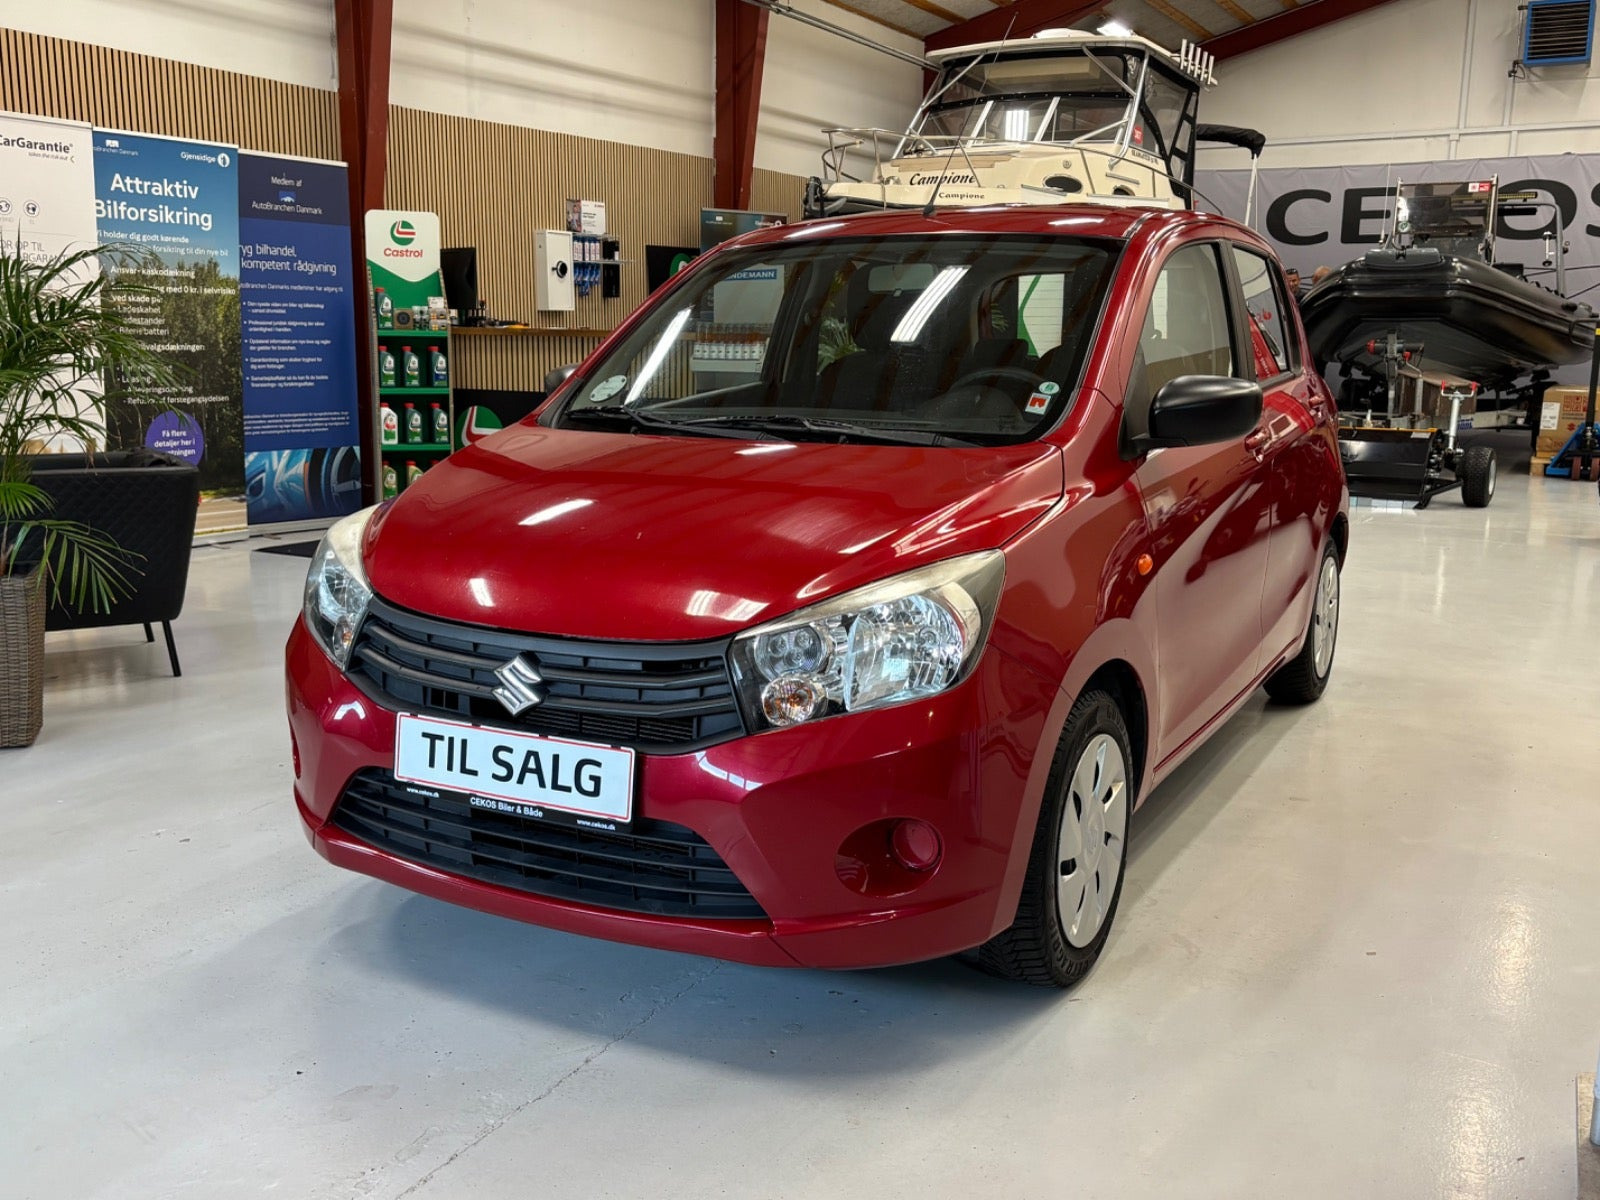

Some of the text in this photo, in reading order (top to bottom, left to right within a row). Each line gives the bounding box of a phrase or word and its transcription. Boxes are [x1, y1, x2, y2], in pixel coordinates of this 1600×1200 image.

[0, 134, 70, 154] arGarantie
[180, 151, 216, 164] Gjensidige
[909, 172, 977, 186] Campione
[110, 173, 199, 200] Attraktiv
[938, 192, 985, 200] Campione
[252, 201, 323, 215] AutoBranchen Danmark
[1266, 179, 1600, 246] CEO
[95, 199, 212, 231] Bilforsikring
[103, 230, 128, 239] holder
[129, 232, 141, 242] dig
[141, 233, 159, 242] godt
[30, 241, 44, 252] TIL
[207, 248, 219, 257] nye
[239, 244, 252, 257] yg
[383, 248, 423, 258] Castrol
[241, 258, 337, 276] kompetent rådgivning
[729, 271, 775, 279] NDEMANN
[165, 285, 182, 293] med
[184, 285, 188, 293] 0
[420, 731, 603, 798] TIL SALG
[470, 796, 543, 818] CEKOS Biler & Både
[576, 819, 616, 831] www.cekos.dk
